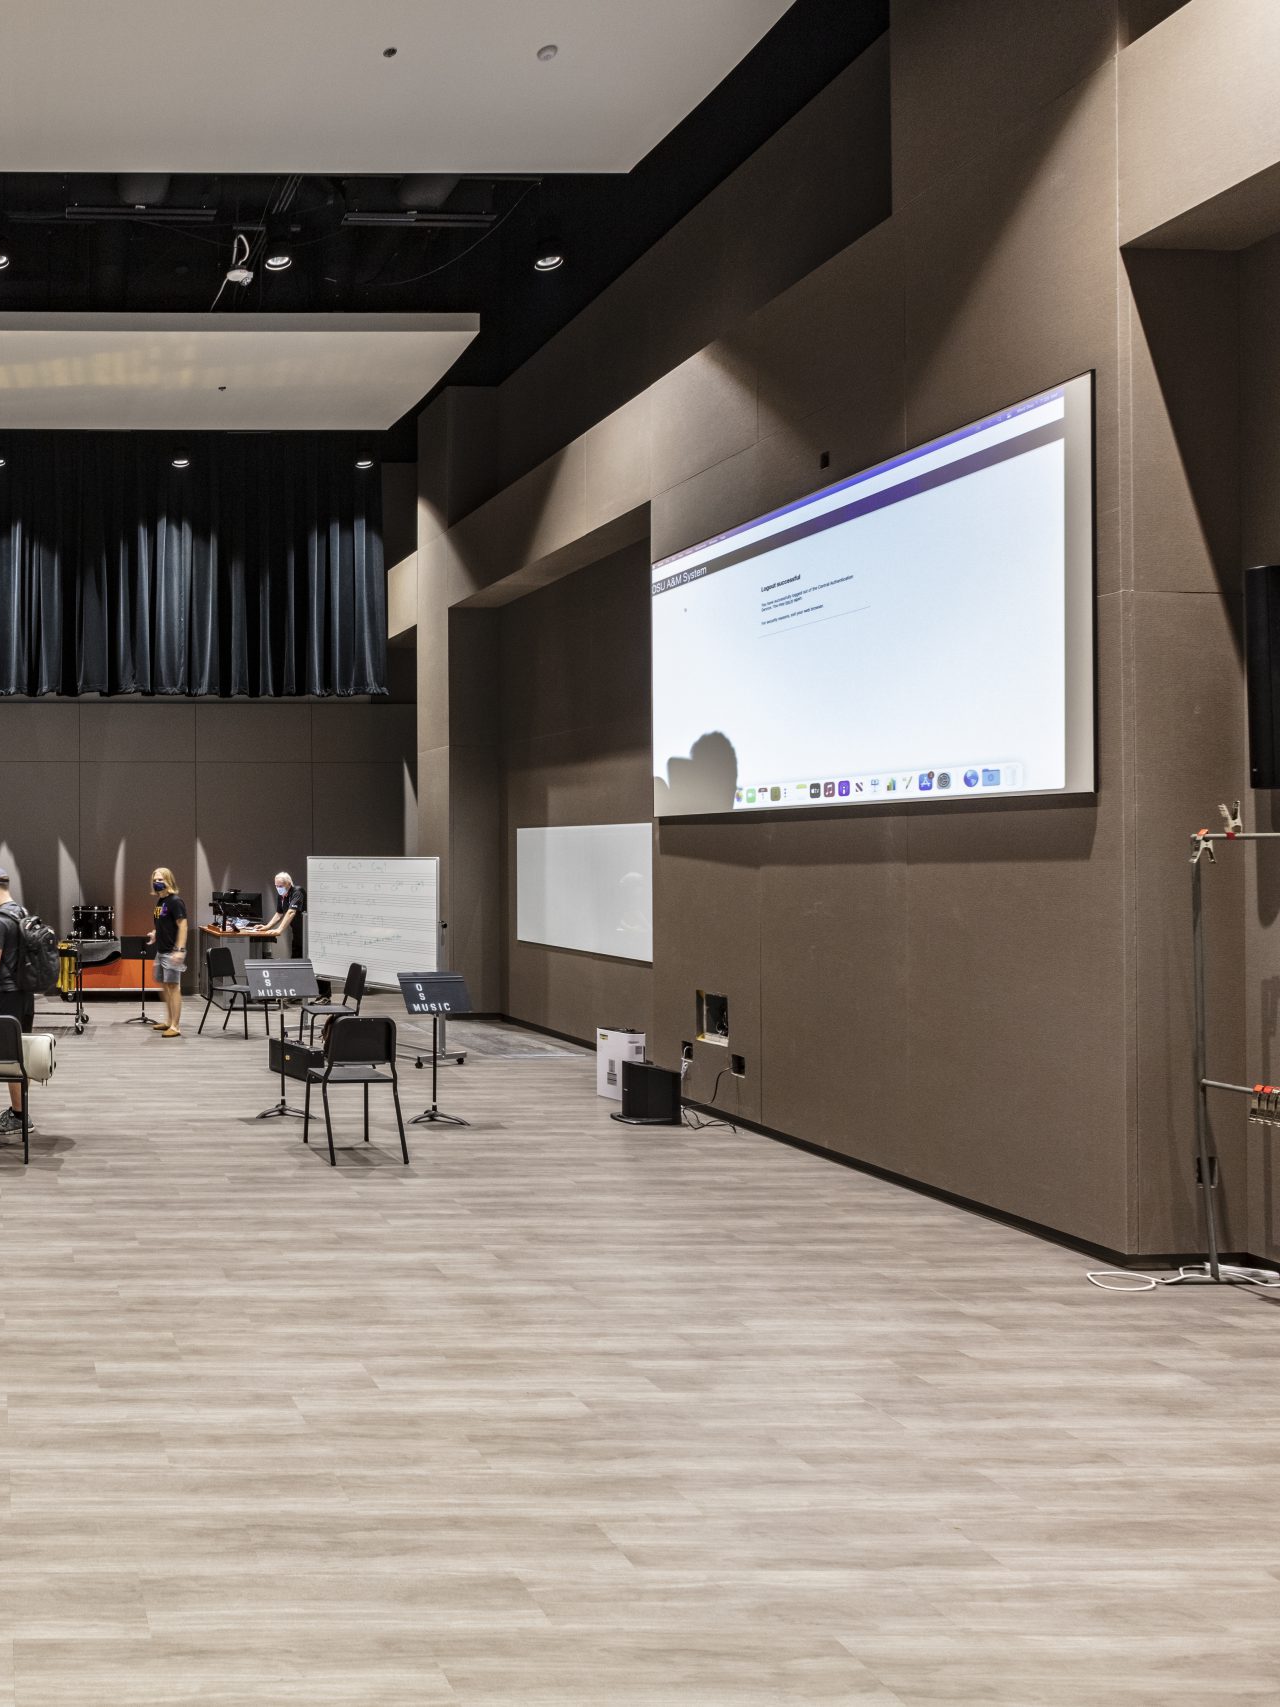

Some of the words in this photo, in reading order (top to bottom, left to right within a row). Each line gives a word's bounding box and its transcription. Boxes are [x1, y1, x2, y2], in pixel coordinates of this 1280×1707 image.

[652, 580, 666, 594] OSU
[666, 574, 682, 589] A&M
[683, 567, 707, 583] System
[761, 582, 776, 592] Logout
[777, 574, 801, 587] successful
[262, 970, 270, 978] O
[264, 979, 272, 987] S
[415, 983, 423, 992] O
[257, 988, 297, 997] MUSIC
[418, 992, 426, 1001] S
[412, 1002, 451, 1012] MUSIC
